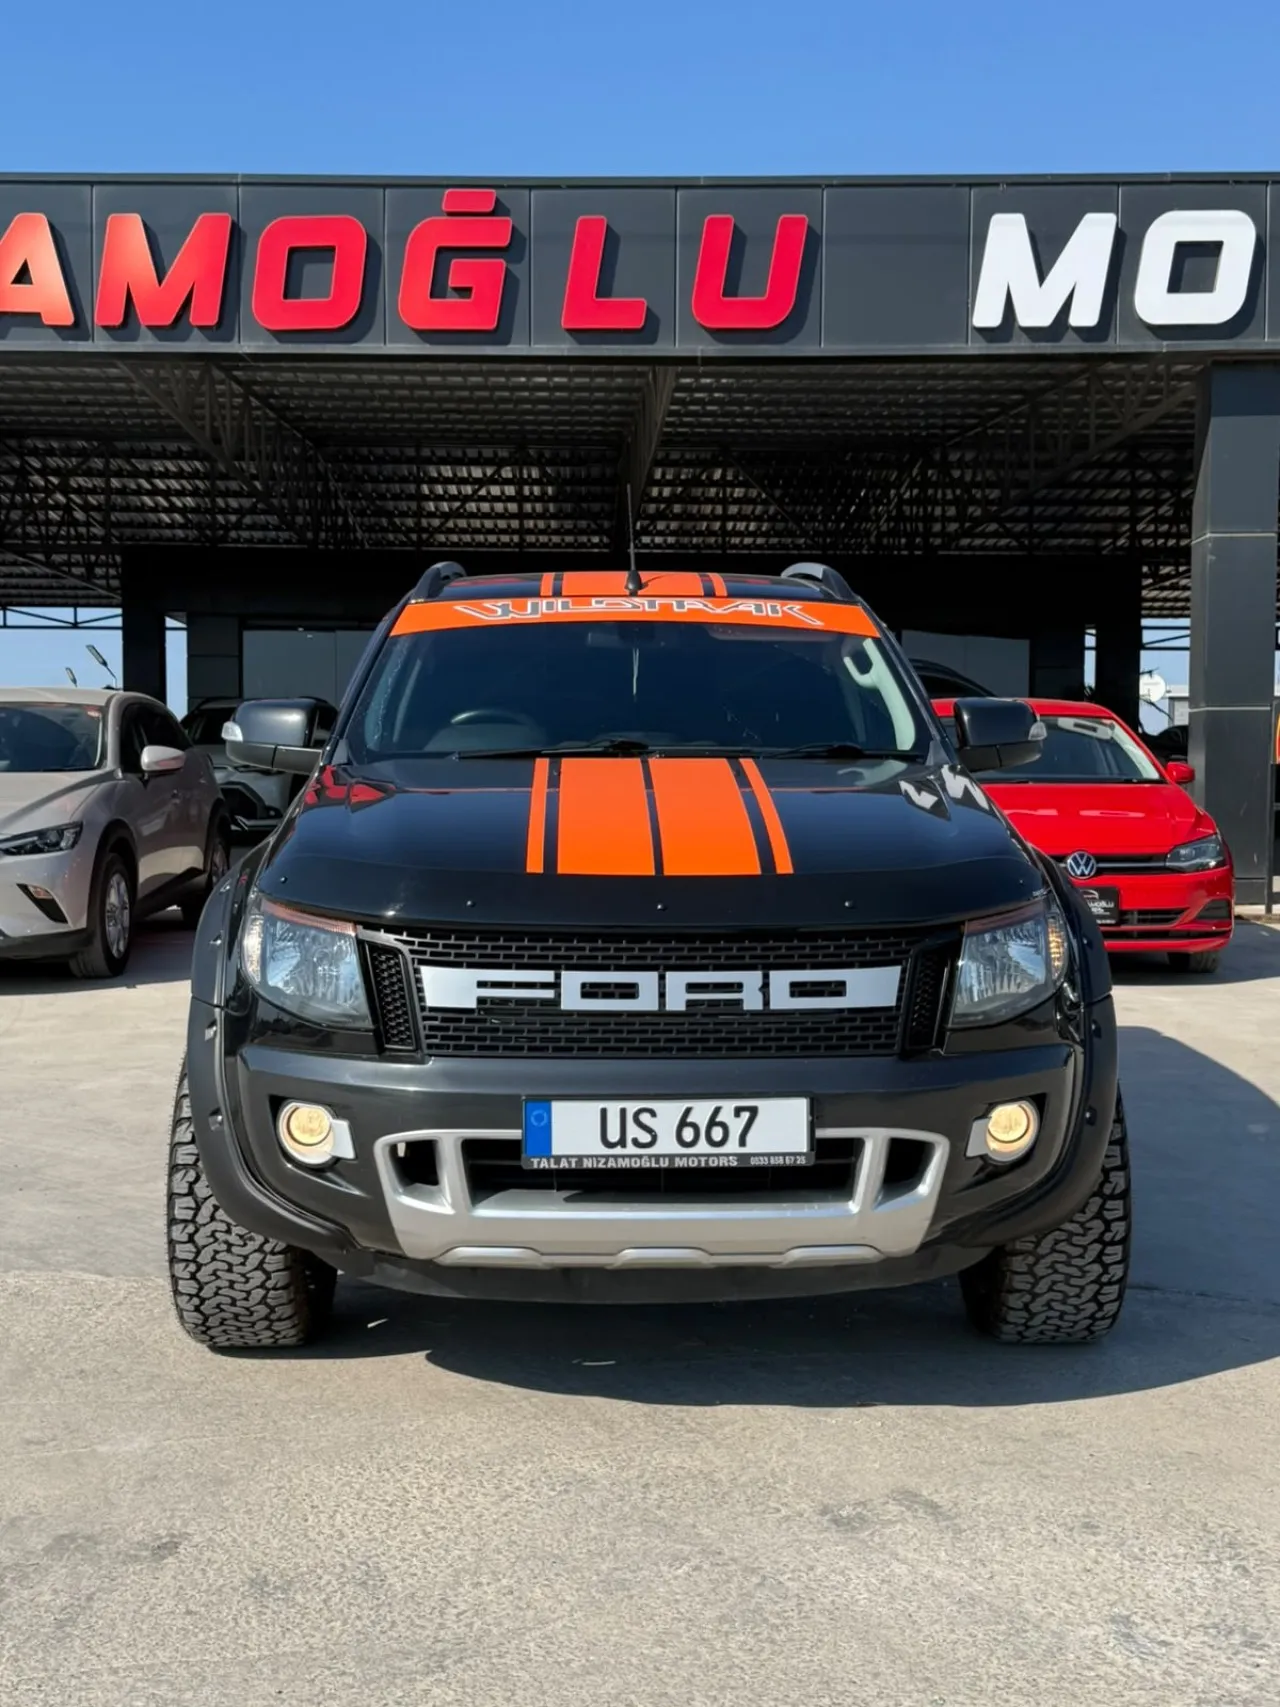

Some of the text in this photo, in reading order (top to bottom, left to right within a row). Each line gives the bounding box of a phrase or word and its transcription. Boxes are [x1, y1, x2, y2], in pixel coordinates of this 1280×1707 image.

[972, 209, 1257, 328] MO
[453, 597, 824, 626] WILDTRAK
[419, 965, 902, 1011] FORD
[599, 1104, 759, 1149] US 667
[530, 1157, 578, 1169] TALAT
[674, 1155, 739, 1168] MOTORS
